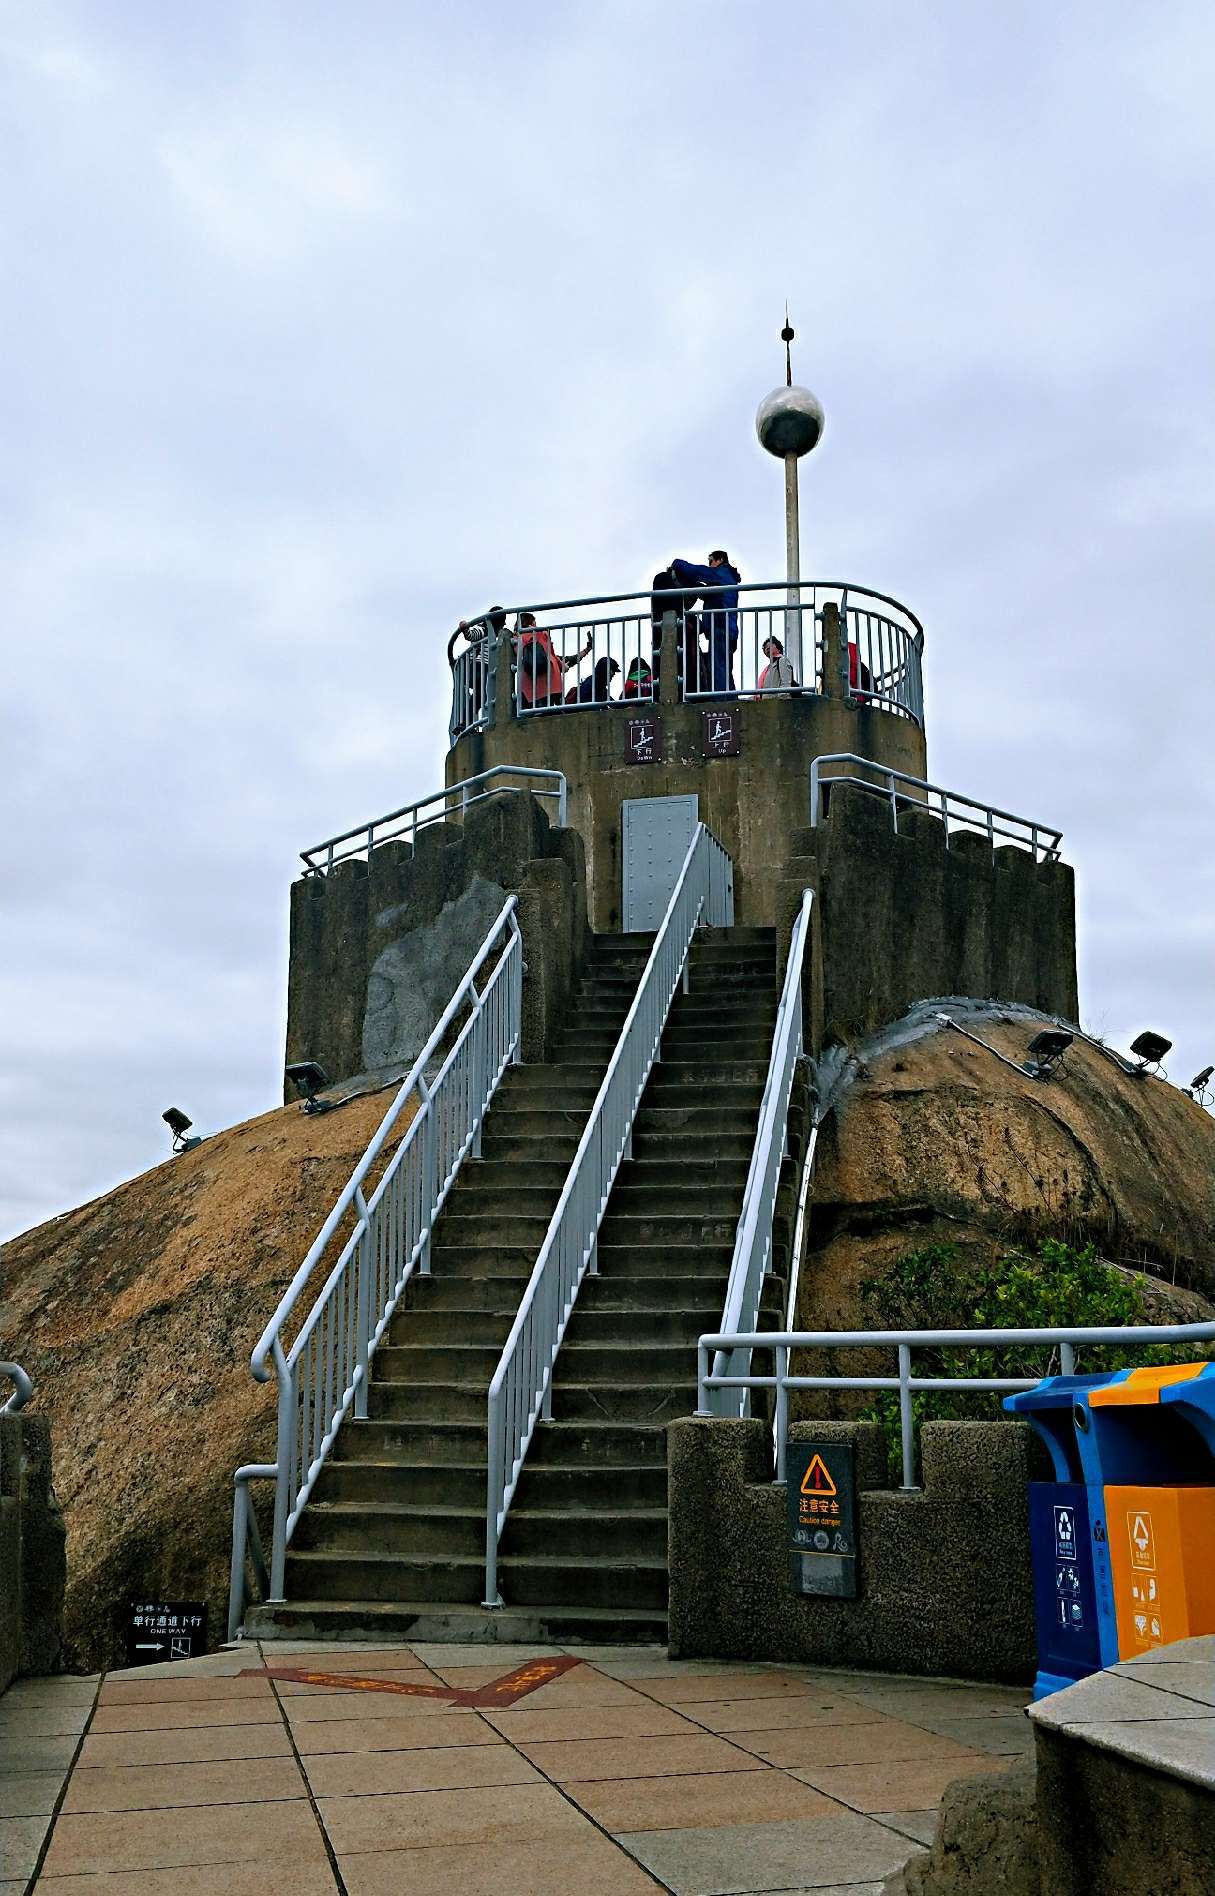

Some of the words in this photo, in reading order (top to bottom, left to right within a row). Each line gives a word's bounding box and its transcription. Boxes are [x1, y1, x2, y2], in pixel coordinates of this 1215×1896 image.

[800, 1498, 839, 1513] 注意安全
[133, 1616, 202, 1627] 单行通道下行
